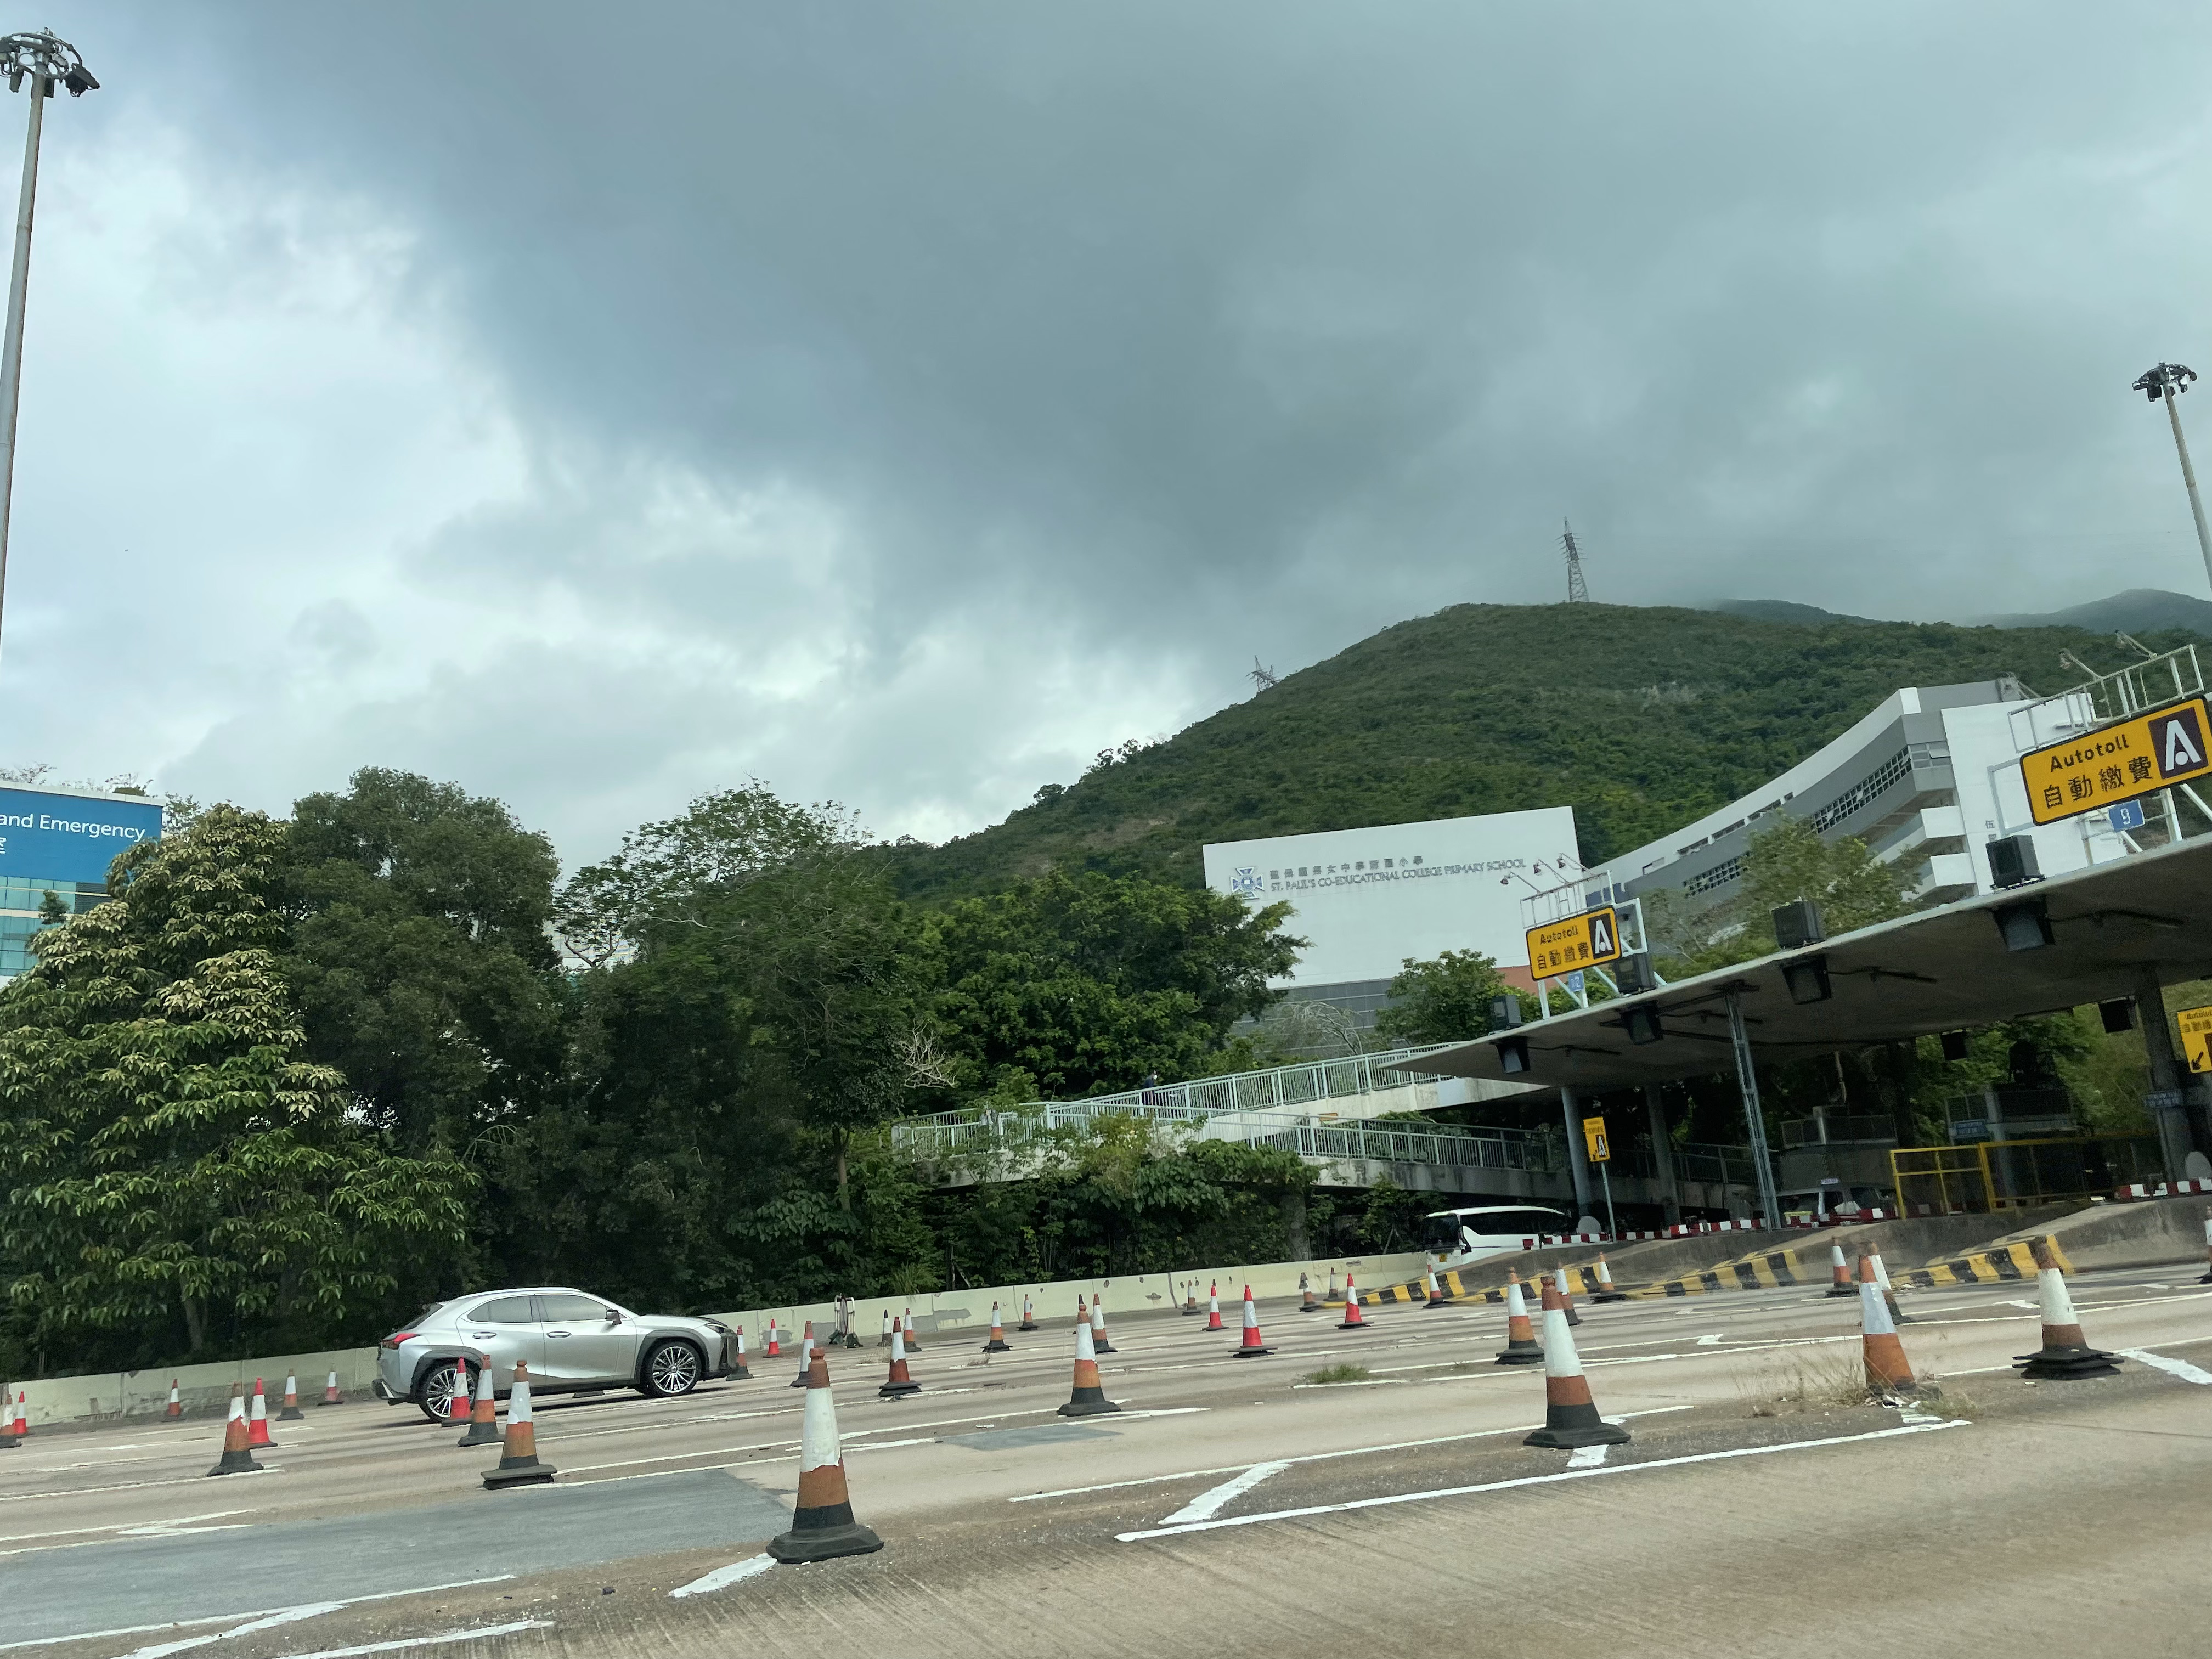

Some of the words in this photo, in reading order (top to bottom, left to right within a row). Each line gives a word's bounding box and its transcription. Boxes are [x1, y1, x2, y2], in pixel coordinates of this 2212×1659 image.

[2050, 733, 2130, 773] Autotoll
[2043, 755, 2153, 810] 自動繳費
[0, 814, 33, 828] and
[40, 814, 146, 842] Emergency
[2119, 807, 2131, 826] 9
[1271, 882, 1284, 891] ST.
[1286, 878, 1316, 891] PAUL'S
[1318, 870, 1400, 887] CO-EDUCATIONAL
[1402, 866, 1443, 879] COLLEGE
[1444, 862, 1485, 875] PRIMARY
[1486, 858, 1527, 871] SCHOOL
[1540, 924, 1579, 945] Autotoll
[1537, 941, 1590, 971] 自動繳費
